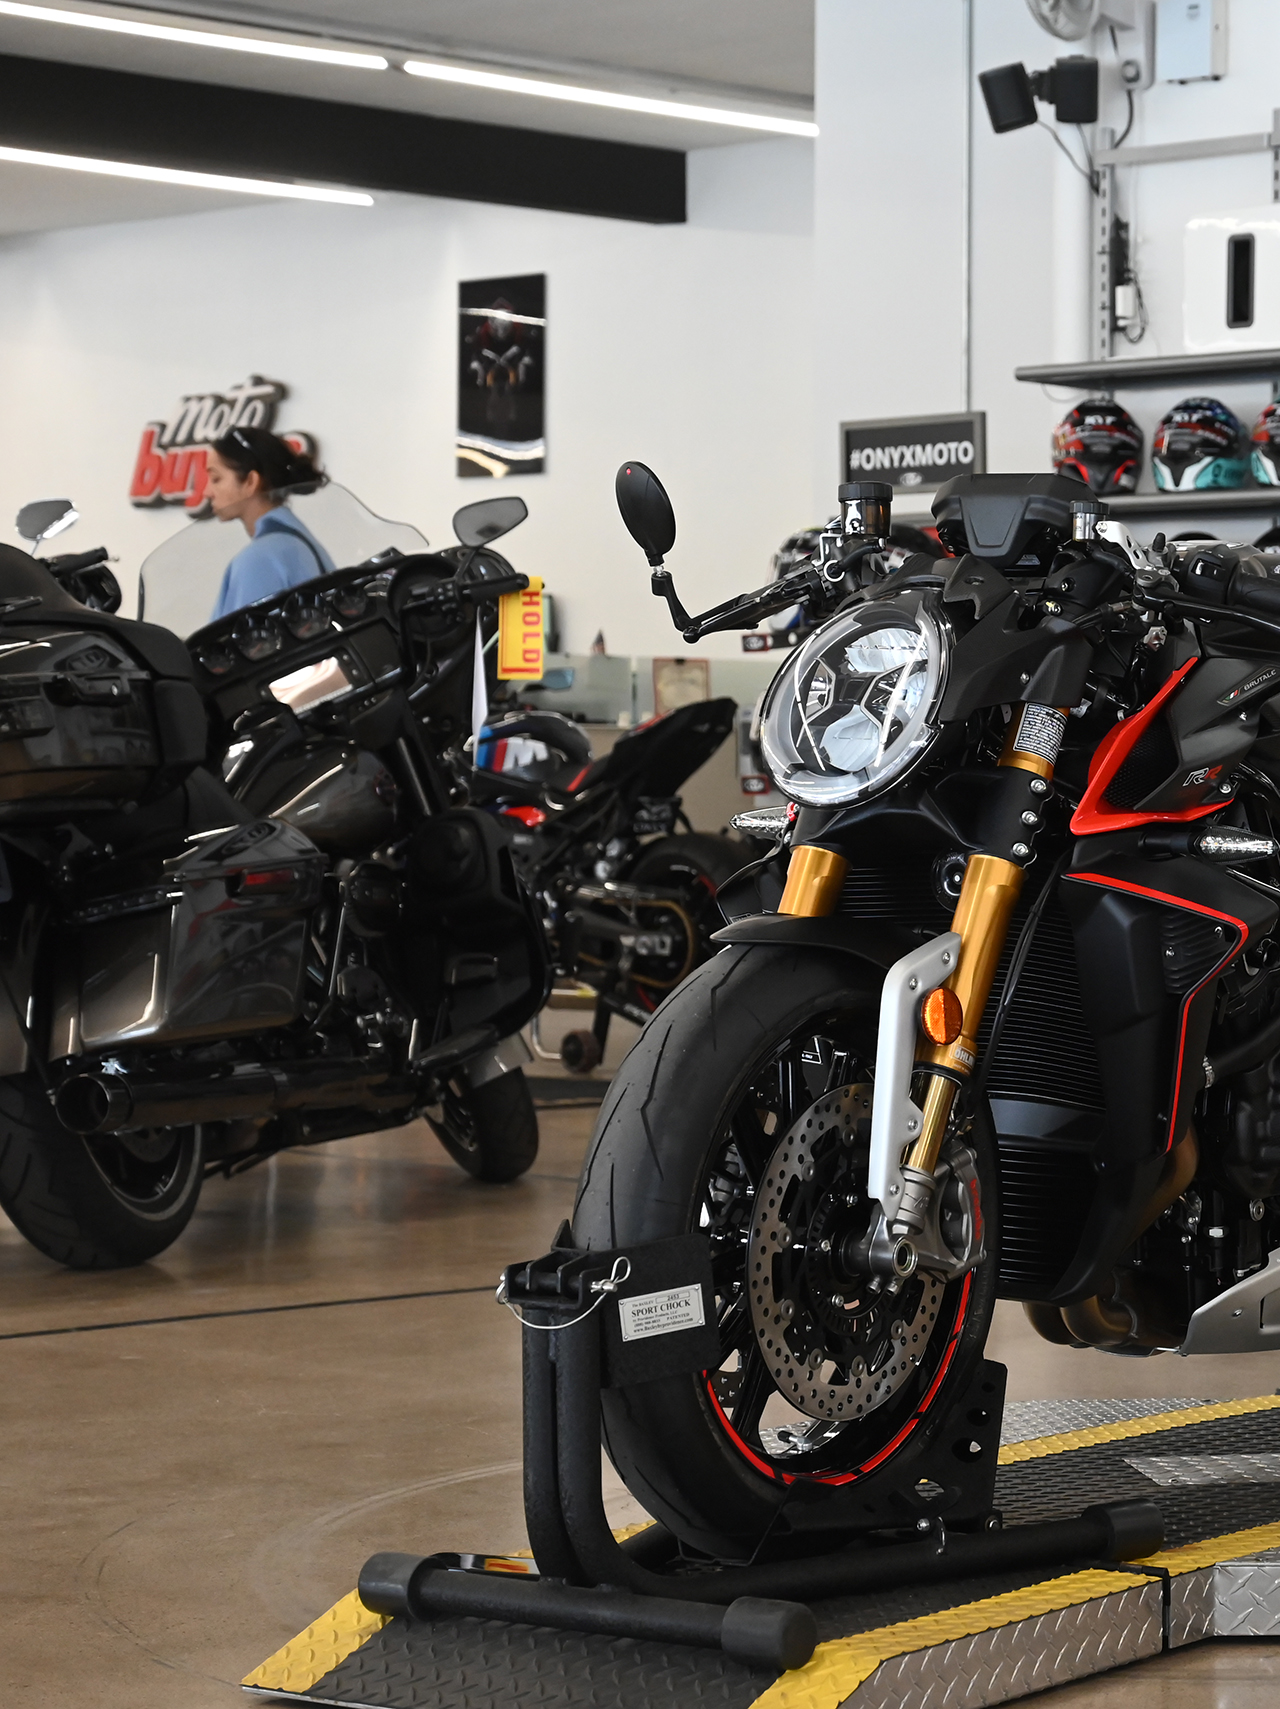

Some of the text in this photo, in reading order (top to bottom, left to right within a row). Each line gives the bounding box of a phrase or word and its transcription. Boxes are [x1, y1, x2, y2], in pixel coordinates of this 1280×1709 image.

[849, 440, 974, 470] #ONYXMOTO
[521, 591, 541, 663] HOLD
[1243, 669, 1277, 691] BRUTALE
[502, 737, 549, 773] M
[1182, 764, 1223, 787] RR
[631, 1299, 691, 1318] SPORT CHOCK
